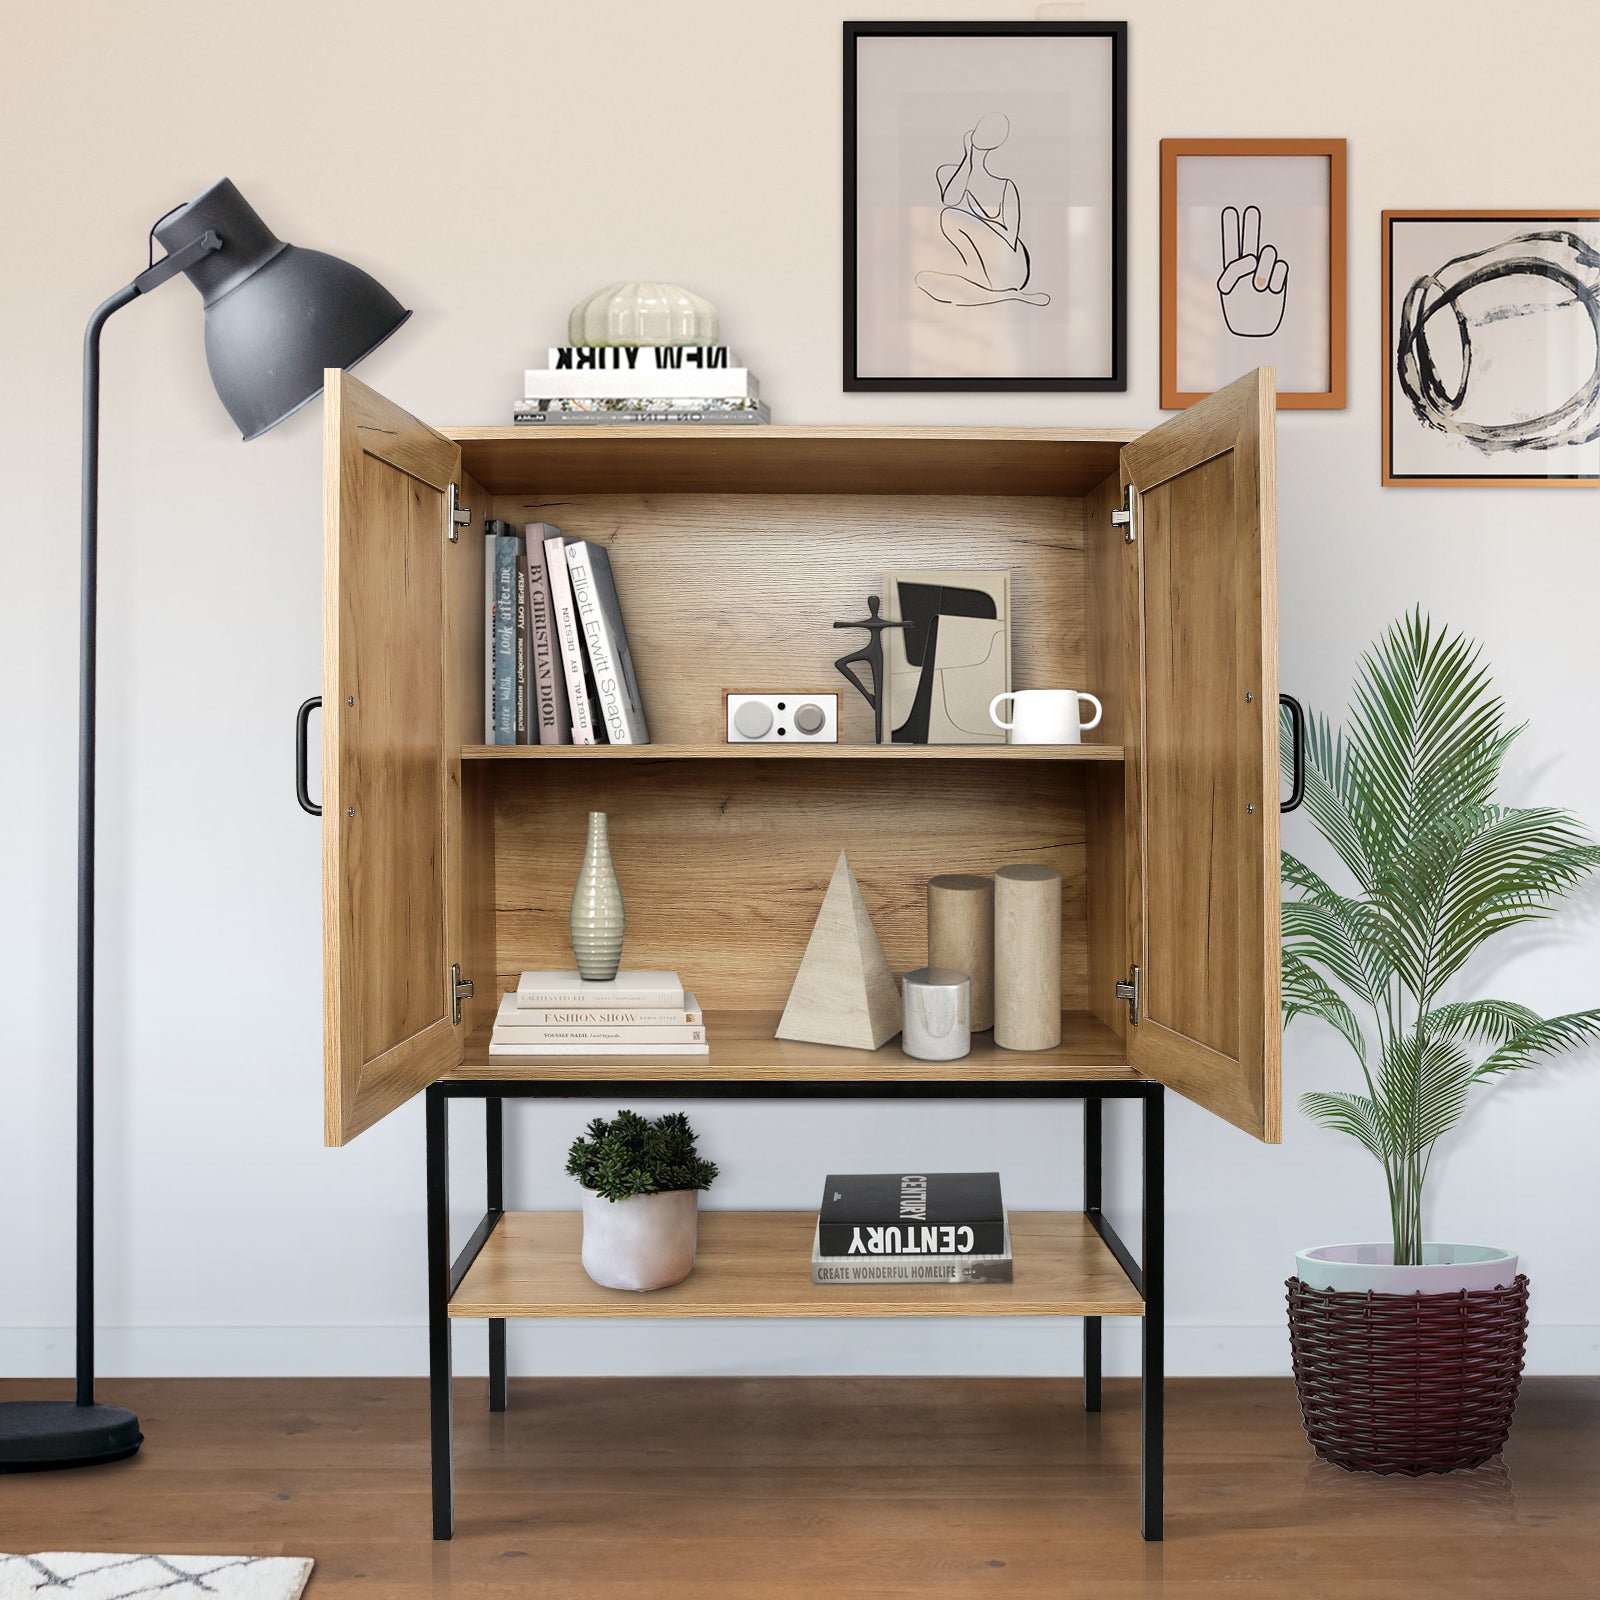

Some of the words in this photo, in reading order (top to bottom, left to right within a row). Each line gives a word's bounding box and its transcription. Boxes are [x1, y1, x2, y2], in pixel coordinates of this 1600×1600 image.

[501, 566, 511, 583] me
[530, 564, 544, 586] BY
[498, 586, 511, 621] after
[498, 625, 513, 655] Look
[532, 590, 552, 680] CHRISTIAN
[561, 607, 575, 651] DESIGN
[570, 565, 594, 616] Elliott
[585, 620, 610, 673] Erwitt
[601, 678, 625, 740] Snaps
[570, 659, 578, 673] BY
[540, 684, 555, 727] DIOR
[574, 680, 588, 728] DIGITAL
[544, 1013, 597, 1023] FASHION
[599, 1013, 638, 1023] SHOW
[899, 1175, 927, 1221] CENTURY
[847, 1225, 975, 1254] CENTURY
[817, 1267, 850, 1280] CREATE
[852, 1266, 909, 1279] WONDERFUL
[911, 1265, 956, 1278] HOMELIFE
